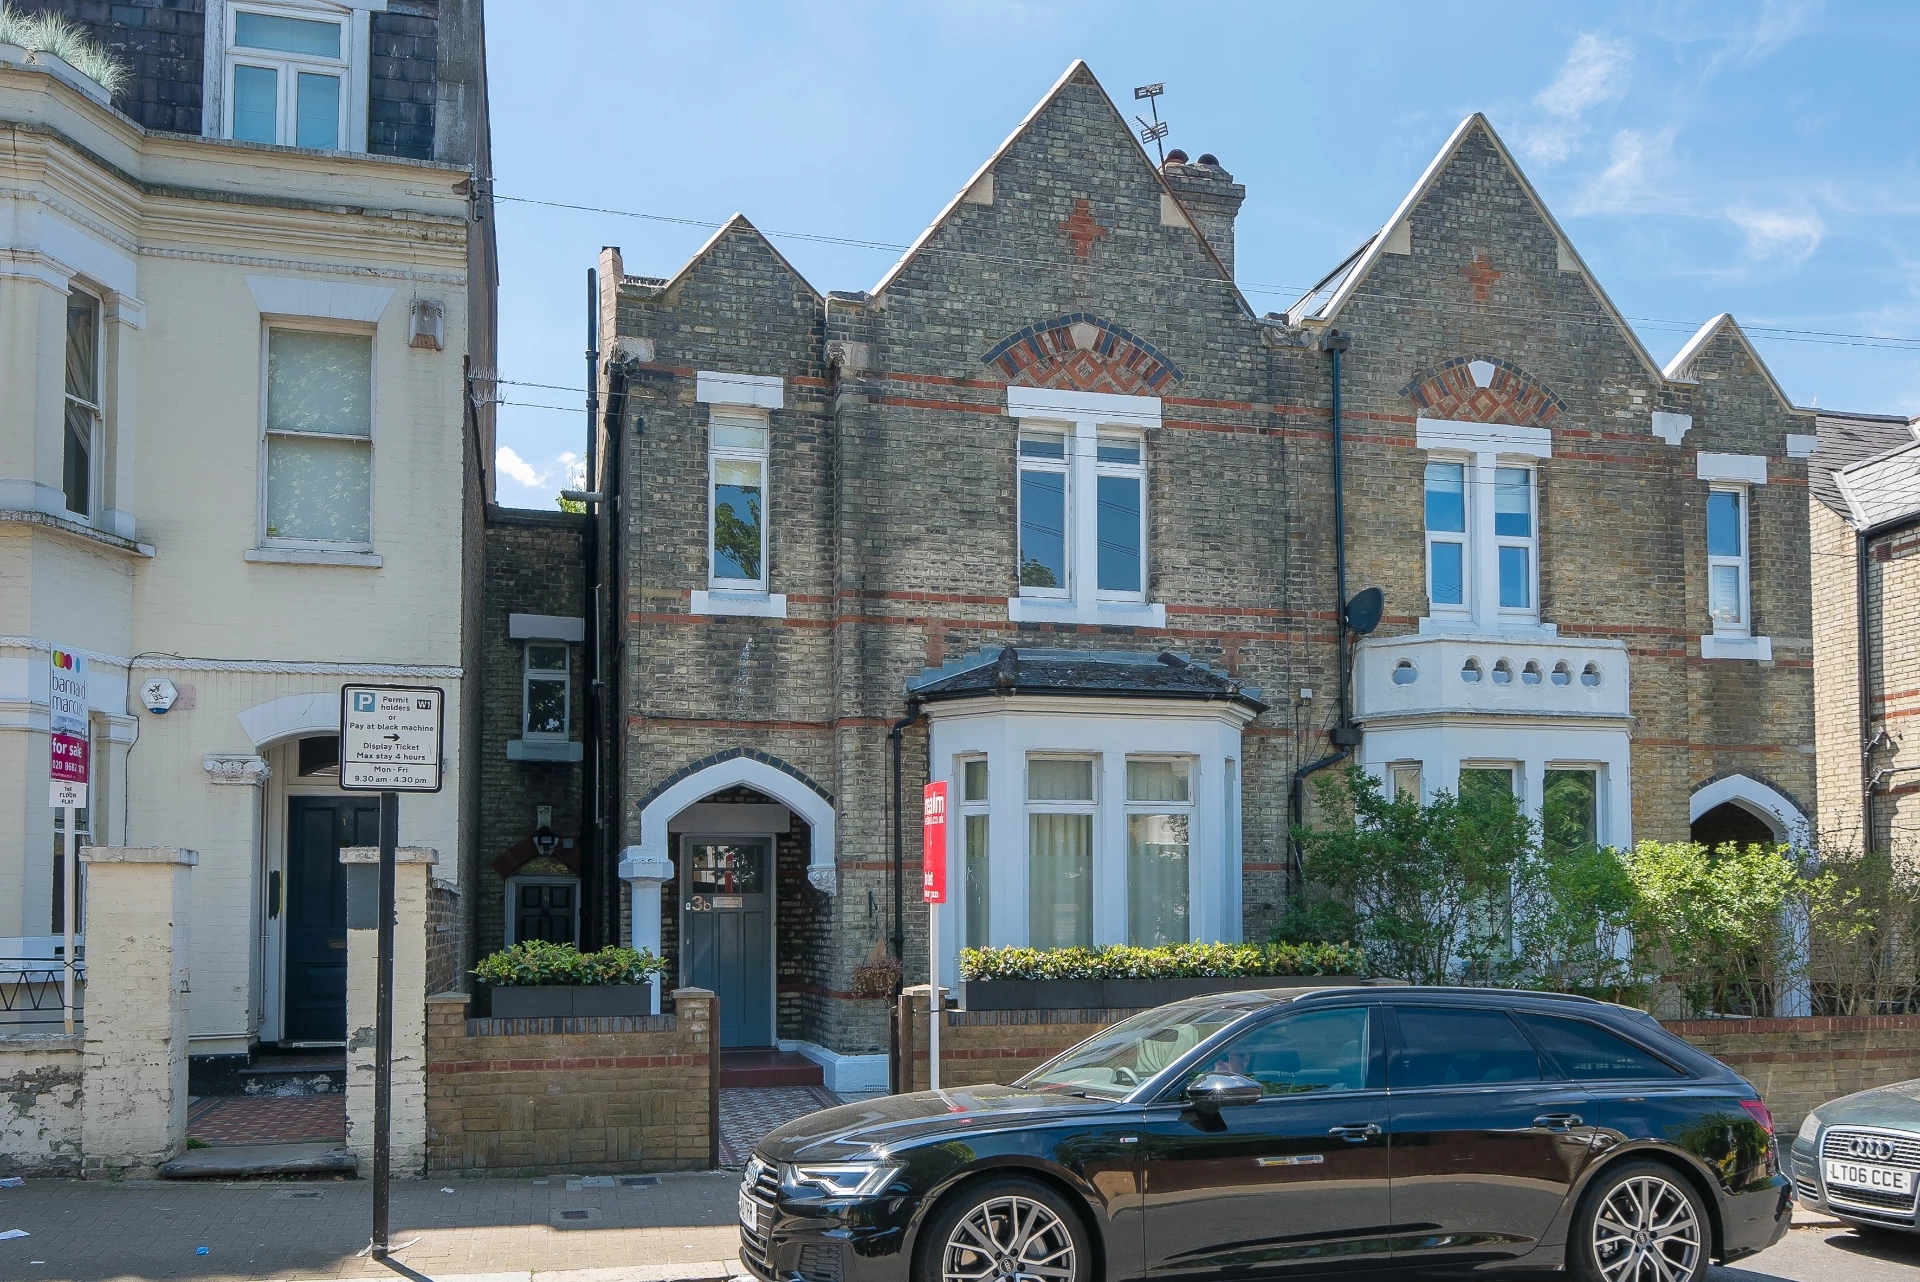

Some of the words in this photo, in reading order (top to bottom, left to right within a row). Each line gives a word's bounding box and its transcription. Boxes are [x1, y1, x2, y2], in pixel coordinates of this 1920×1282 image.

[52, 670, 86, 700] barnard
[382, 696, 409, 704] Permit
[417, 700, 431, 709] W1
[52, 695, 84, 717] marcus
[380, 703, 411, 712] holders
[349, 722, 364, 730] Pay
[401, 724, 434, 732] machine
[52, 738, 67, 755] for
[69, 742, 82, 758] sale
[363, 742, 393, 751] Display
[375, 752, 393, 760] stay
[393, 776, 413, 784] 4.30
[692, 896, 712, 911] 3b
[1832, 1164, 1867, 1183] LT06
[1872, 1170, 1904, 1189] CCE
